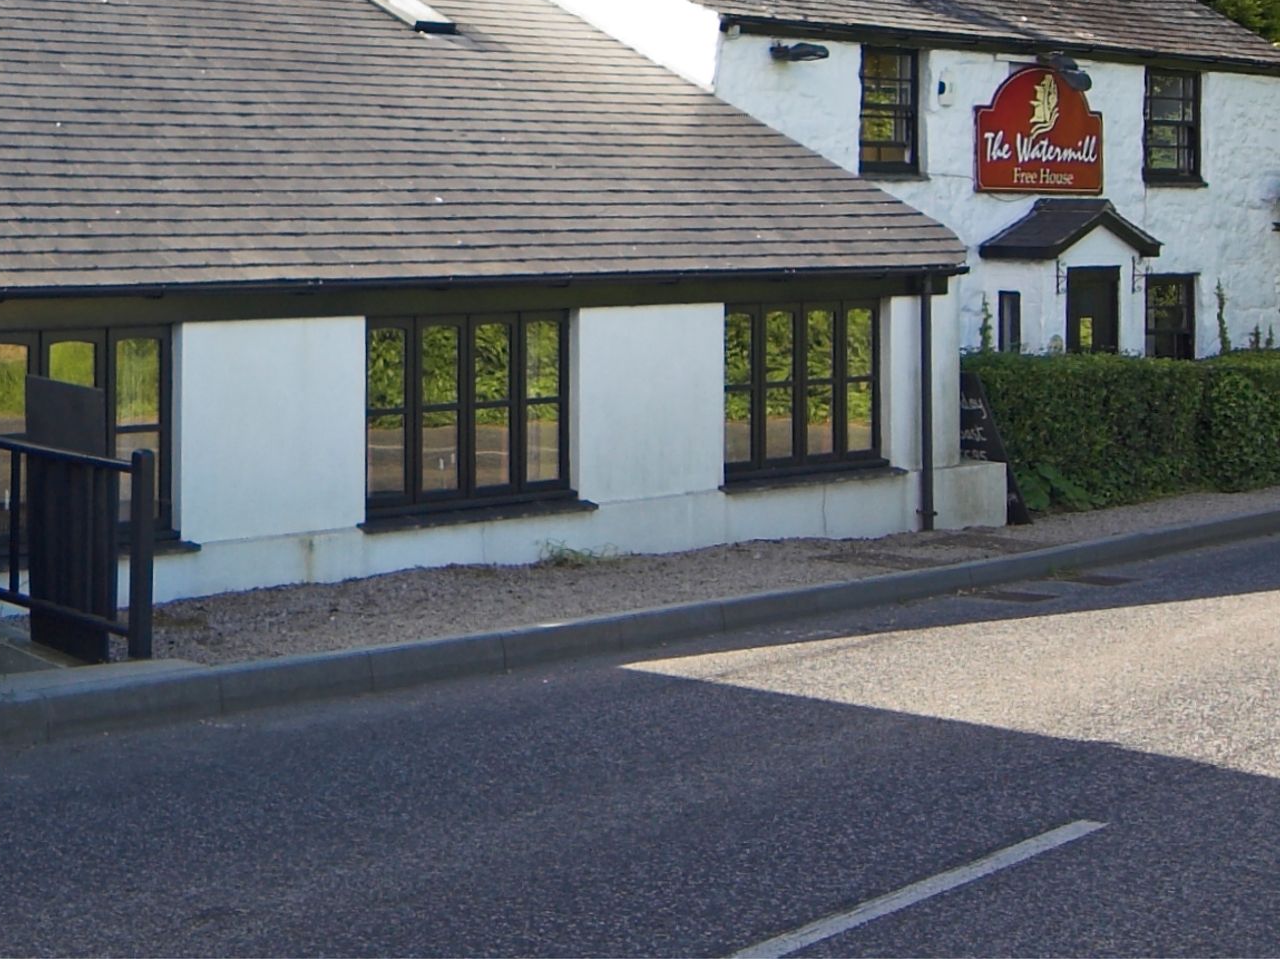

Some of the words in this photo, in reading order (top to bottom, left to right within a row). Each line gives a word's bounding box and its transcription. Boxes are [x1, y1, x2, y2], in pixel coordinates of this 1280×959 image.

[984, 130, 1012, 163] The
[1016, 132, 1097, 163] Watermill
[1013, 167, 1038, 184] Free
[1039, 168, 1074, 185] House
